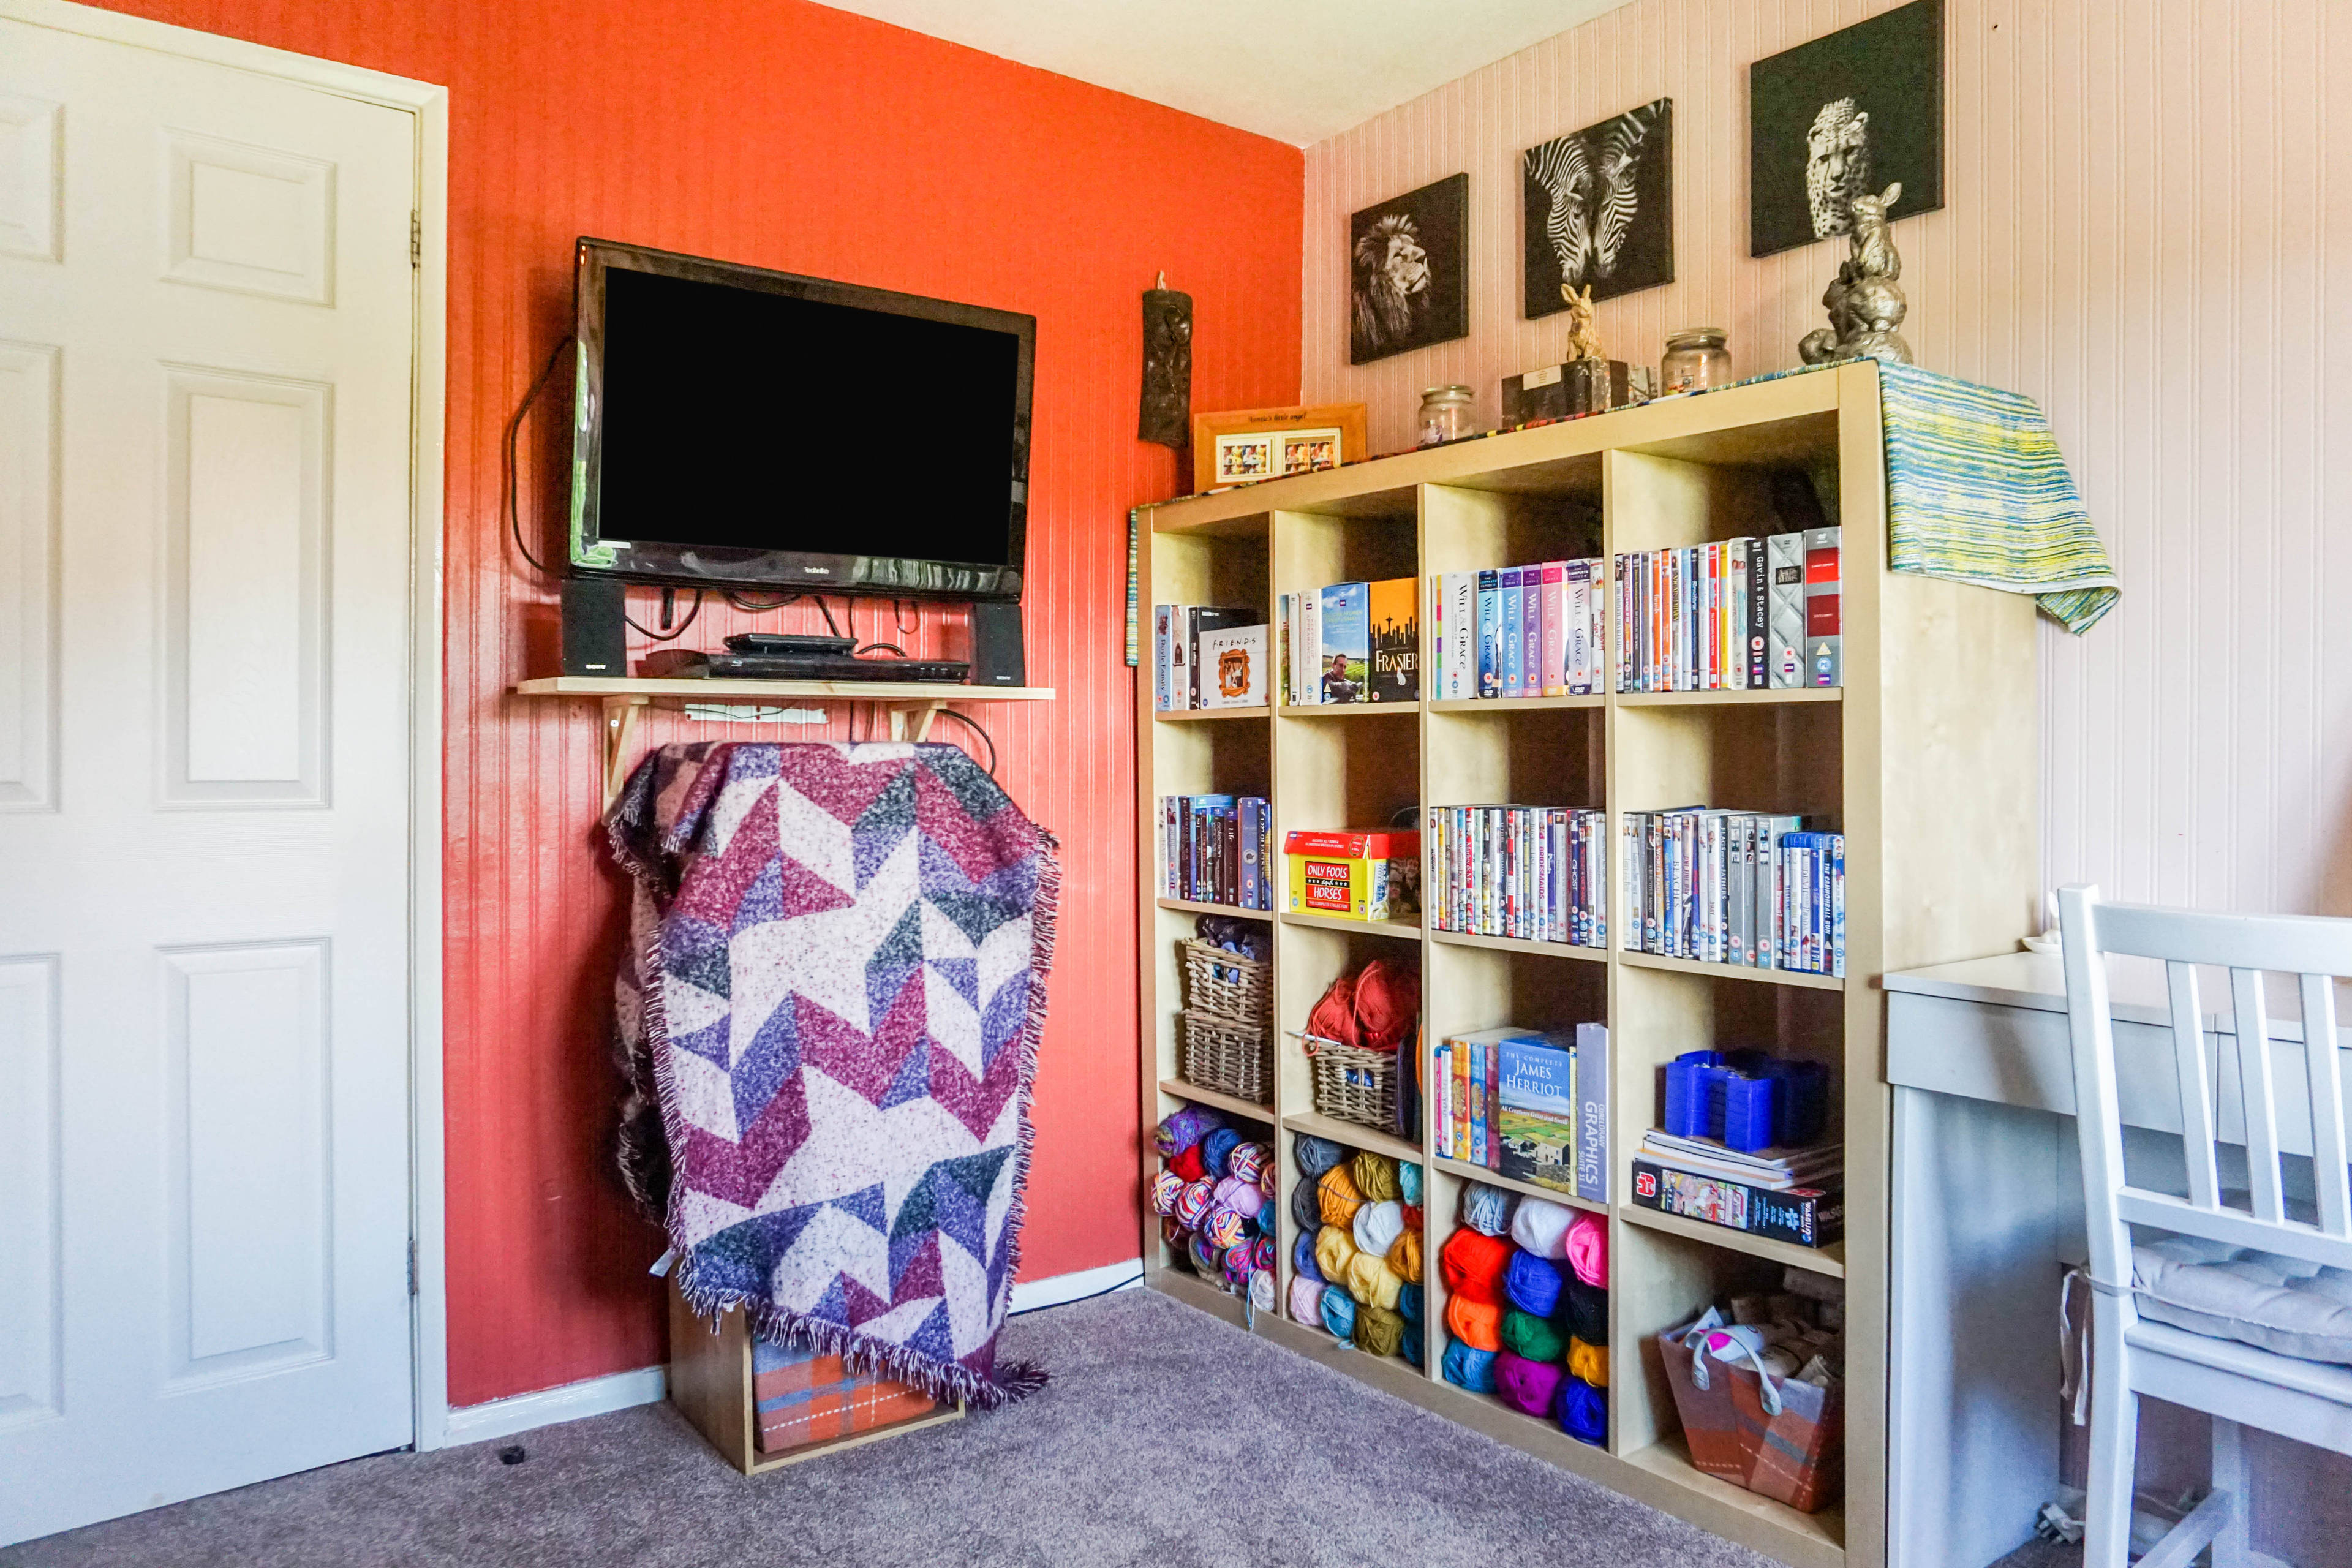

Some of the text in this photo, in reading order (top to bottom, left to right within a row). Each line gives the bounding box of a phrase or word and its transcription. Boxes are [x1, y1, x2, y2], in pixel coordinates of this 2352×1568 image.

[1290, 412, 1307, 422] angel
[1755, 595, 1765, 628] Stacey
[1376, 650, 1419, 672] FRASIER
[1308, 865, 1347, 878] ONLY FOOLS
[1321, 877, 1334, 886] and
[1467, 873, 1472, 884] Me
[1314, 887, 1342, 900] HORSES
[1524, 1055, 1562, 1067] COMPLETE
[1515, 1060, 1552, 1079] JAMES
[1507, 1074, 1562, 1096] HERRIOT
[1509, 1107, 1530, 1116] Creatures
[1554, 1117, 1569, 1125] Small
[1585, 1101, 1598, 1185] GRAPHICS
[1578, 1173, 1585, 1182] 11
